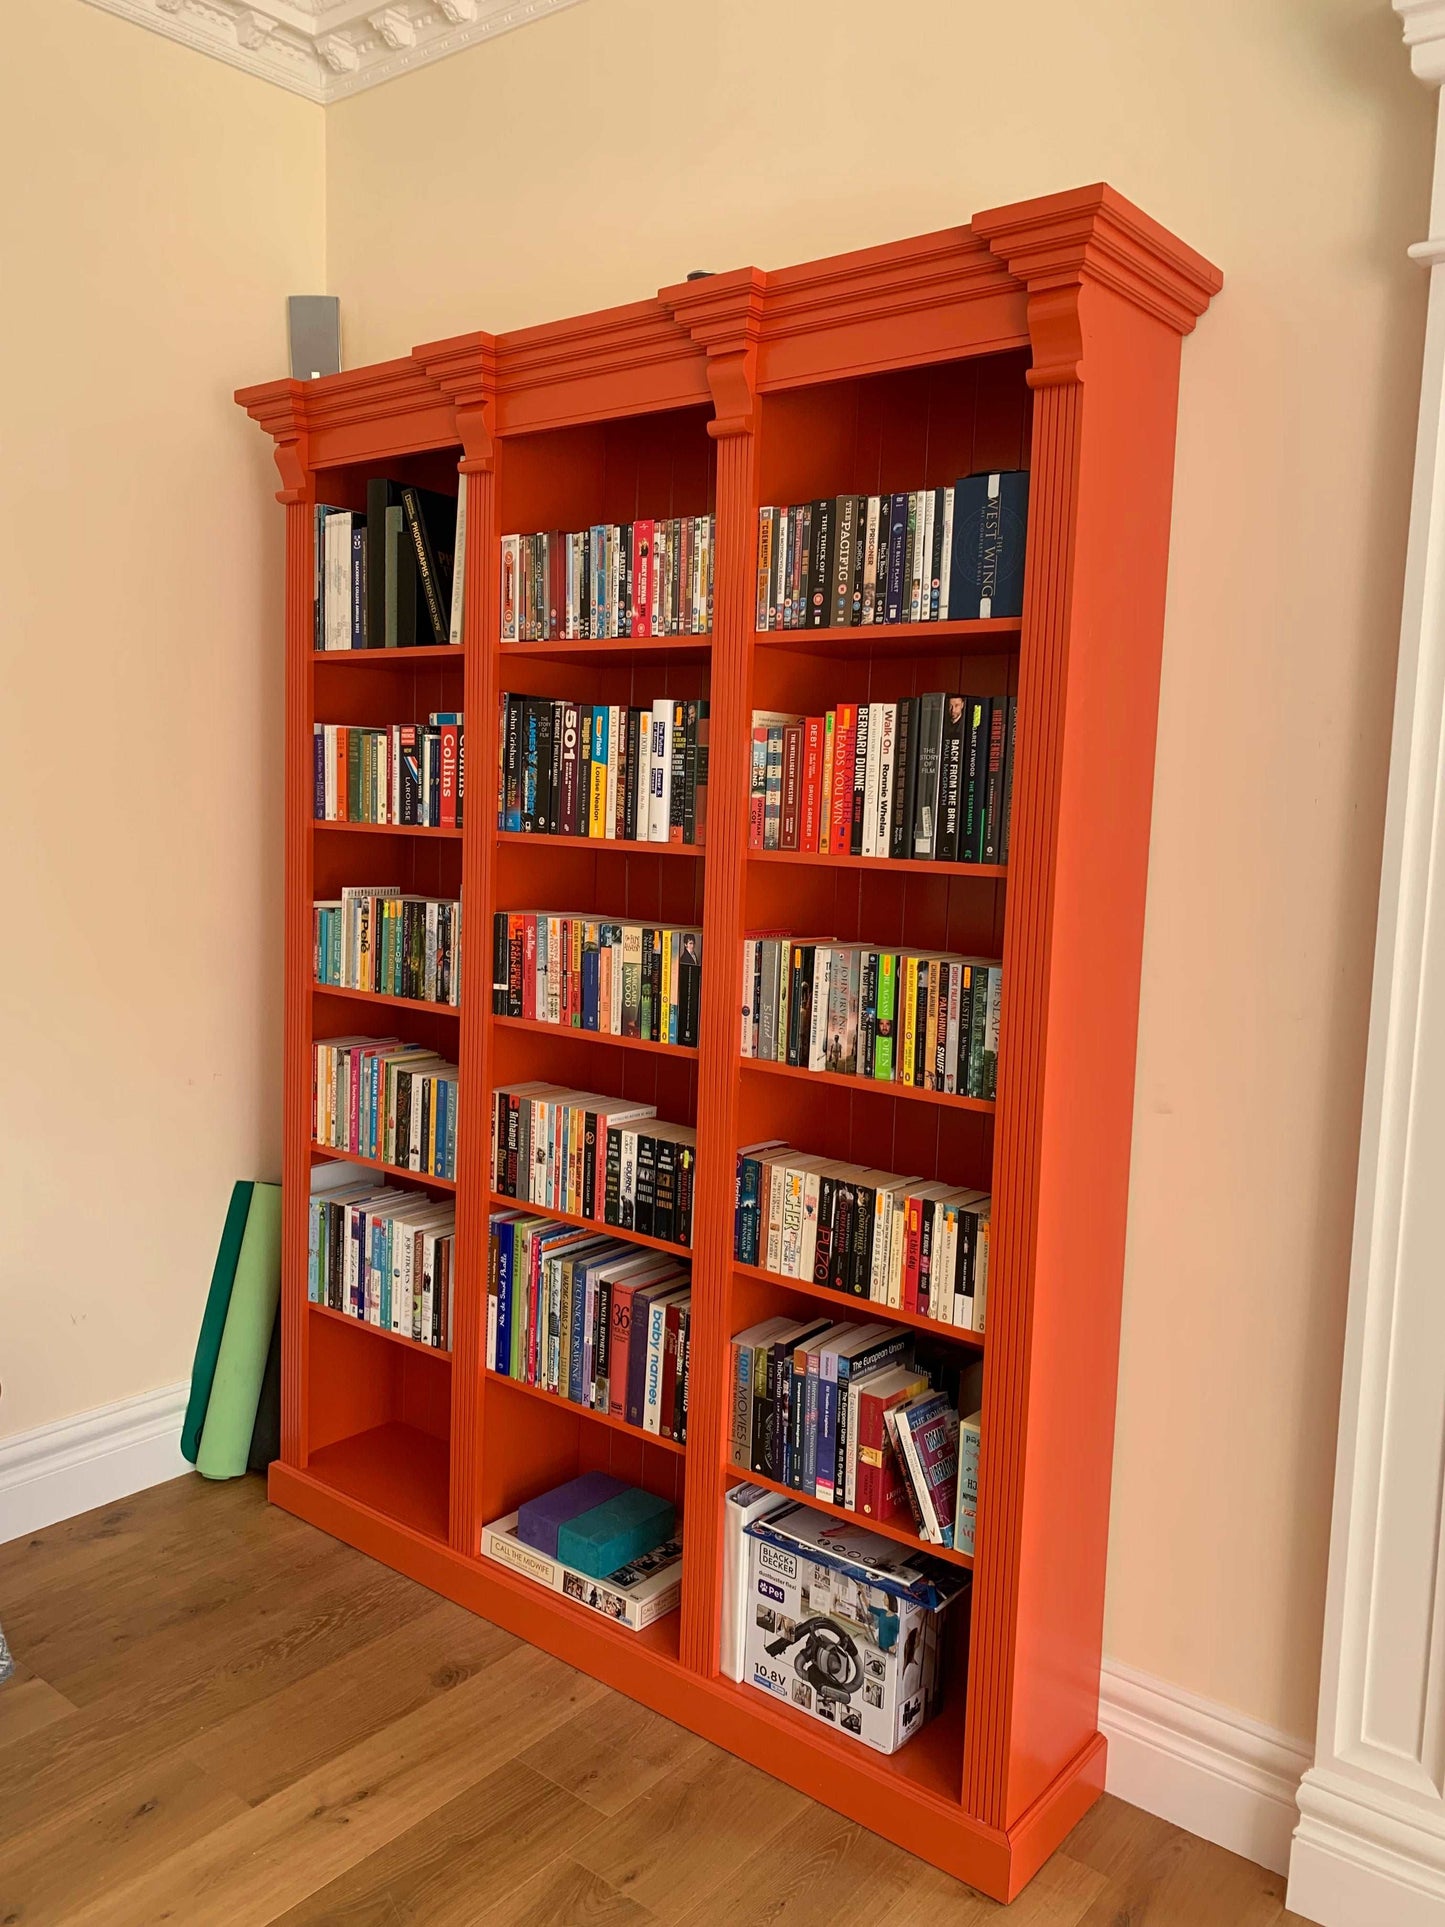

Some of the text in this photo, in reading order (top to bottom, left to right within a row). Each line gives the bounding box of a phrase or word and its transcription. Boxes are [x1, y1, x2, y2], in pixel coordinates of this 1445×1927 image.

[838, 521, 851, 581] PACIFIC
[868, 528, 876, 565] PRISONER
[982, 497, 997, 598] WEST WING
[412, 522, 441, 631] PHOTOGRAPHS THEN AND NOW
[819, 562, 825, 573] OF
[819, 575, 824, 583] IT
[510, 708, 518, 730] John
[564, 709, 577, 759] 501
[810, 724, 818, 748] DEBT
[582, 718, 591, 759] Shuggie Bain
[854, 708, 868, 792] BERNARD DUNNE
[989, 709, 1002, 772] HIBERNO-ENGLISH
[443, 734, 455, 797] Collins
[528, 766, 536, 776] A.
[833, 725, 846, 825] HEADS YOU WIN
[842, 725, 855, 824] JEFFREY ARCHER
[879, 711, 893, 837] Walk On Ronnie Whelan
[527, 780, 535, 816] COREY
[941, 764, 949, 805] McGRATH
[946, 739, 959, 834] BACK FROM THE BRINK
[361, 919, 370, 953] Pelé
[763, 1004, 771, 1038] Blessed
[839, 998, 848, 1034] IRVING
[938, 997, 946, 1043] PALAHNIUK
[950, 988, 958, 1020] PALAHNIUK
[961, 994, 969, 1030] AUSTER
[992, 1000, 1001, 1035] SLAP
[882, 1039, 890, 1066] OPEN
[508, 1111, 518, 1150] Archangel
[498, 1149, 507, 1176] Ghost
[743, 1213, 747, 1222] OF
[838, 1201, 848, 1253] GODFATHER
[854, 1207, 866, 1256] GODFATHER'S
[403, 1236, 413, 1284] jojo moyes
[815, 1229, 830, 1279] PUZO
[908, 1239, 918, 1269] this day
[600, 1290, 608, 1324] FINANCIAL
[572, 1278, 583, 1382] TECHNICAL DRAWING
[649, 1309, 663, 1405] baby names
[737, 1353, 748, 1440] 1001 MOVIES
[808, 1423, 816, 1474] Microeconomics
[846, 1440, 854, 1475] WISDOM
[494, 1542, 550, 1575] CALL THE MIDWIFE
[763, 1547, 793, 1565] BLACK+
[763, 1556, 793, 1574] DECKER
[759, 1570, 785, 1585] dustbuster
[769, 1586, 783, 1600] Pet
[754, 1662, 786, 1686] 10.8V
